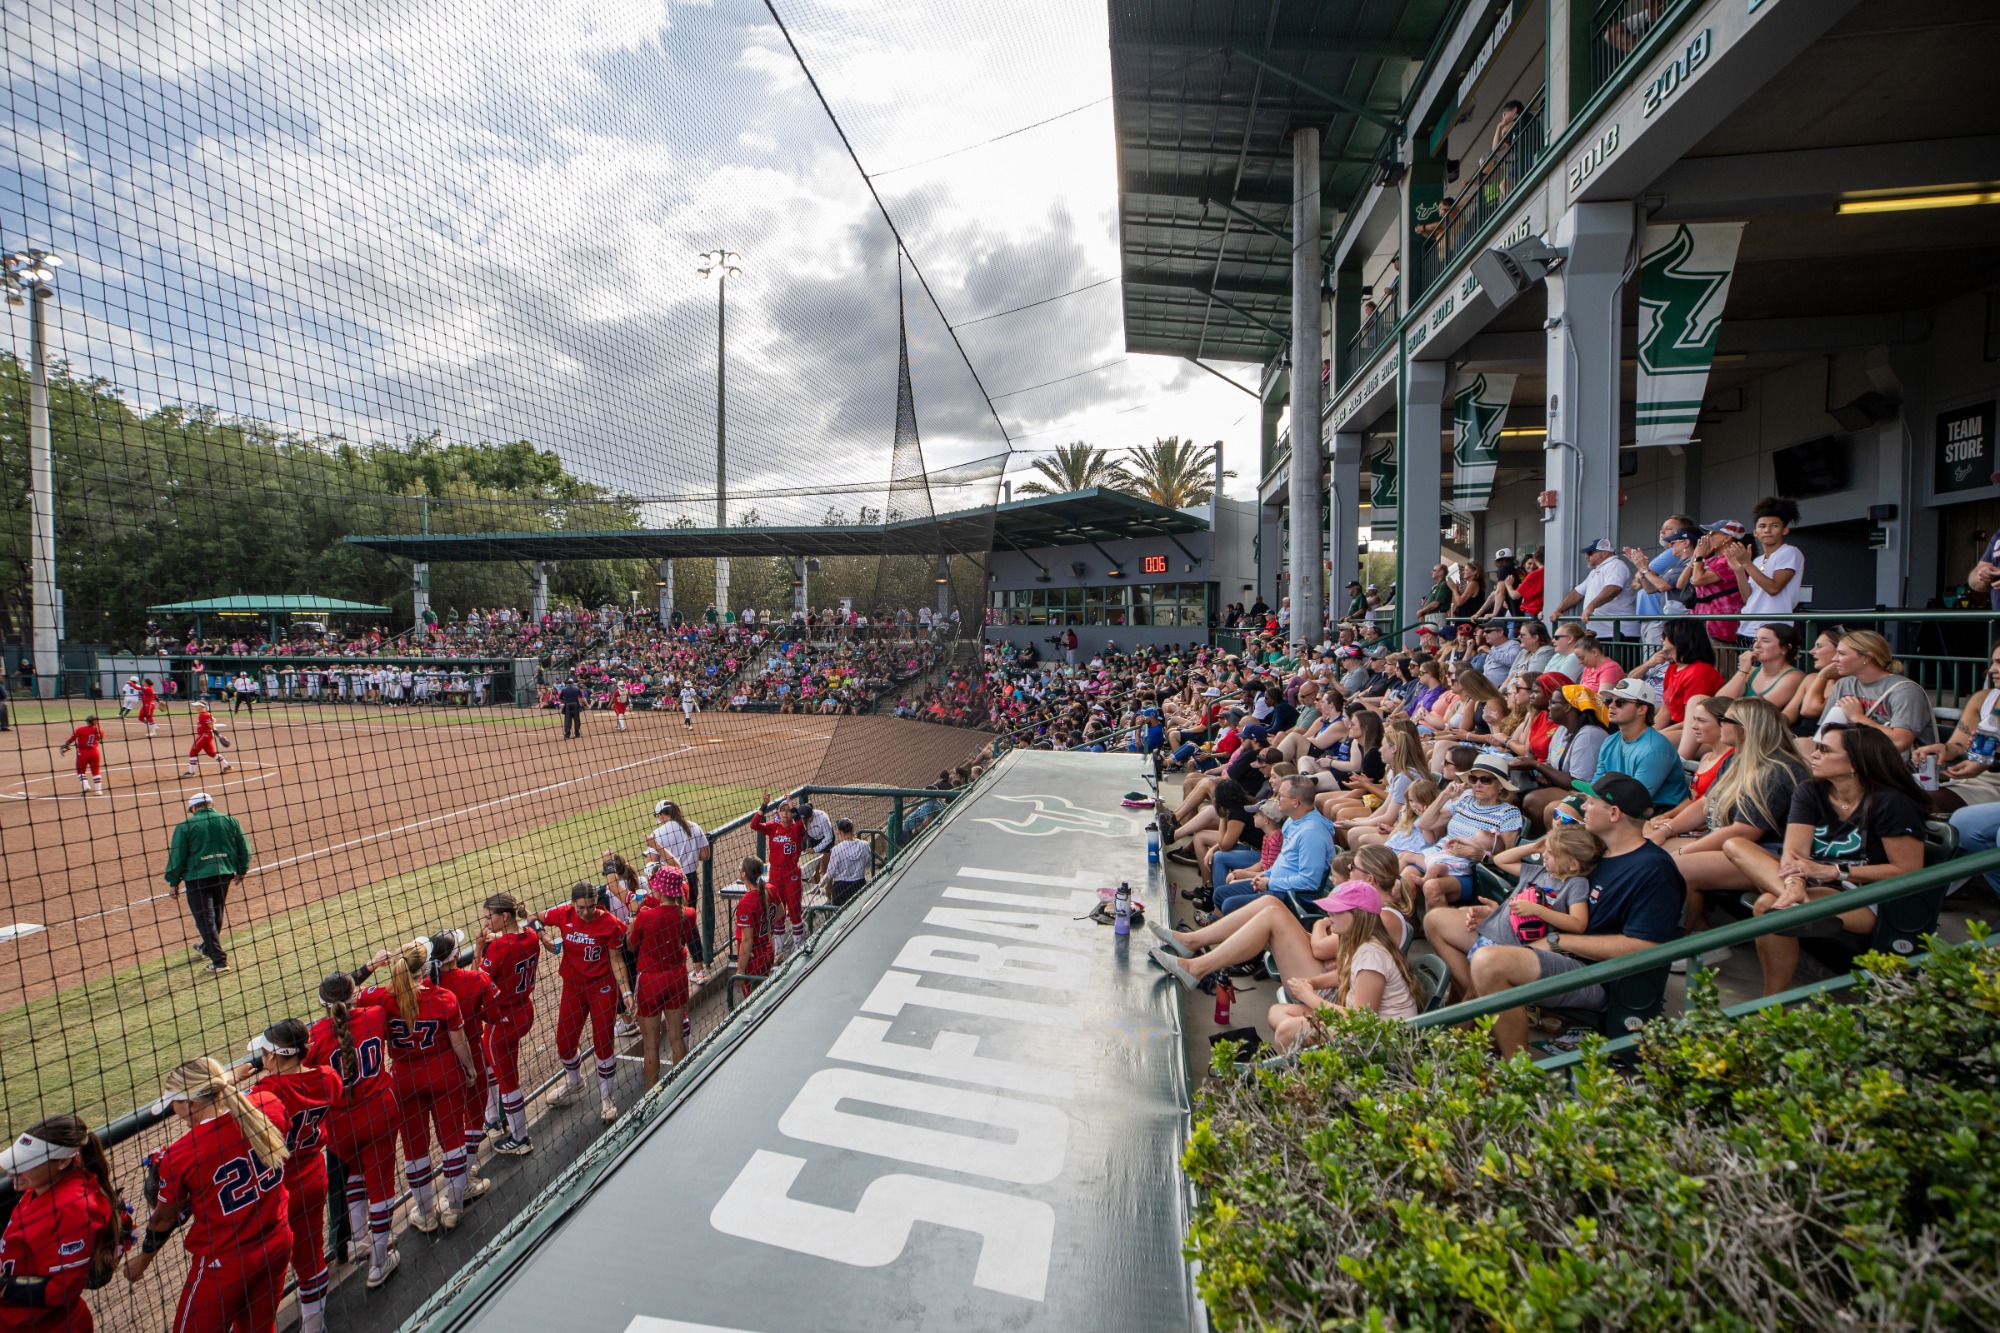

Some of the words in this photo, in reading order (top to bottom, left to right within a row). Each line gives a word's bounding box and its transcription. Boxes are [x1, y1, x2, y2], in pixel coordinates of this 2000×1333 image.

[1407, 323, 1427, 354] 2012
[1432, 295, 1454, 330] 2013
[1461, 274, 1480, 301] 201
[1569, 123, 1619, 193] 2018
[1643, 28, 1711, 119] 2019
[1947, 415, 1982, 442] TEAM
[1945, 436, 1983, 463] STORE
[583, 945, 602, 962] 12
[514, 953, 538, 994] 77
[390, 1018, 439, 1050] 27
[710, 866, 1102, 1302] SOFTBALL
[212, 1147, 285, 1217] 25
